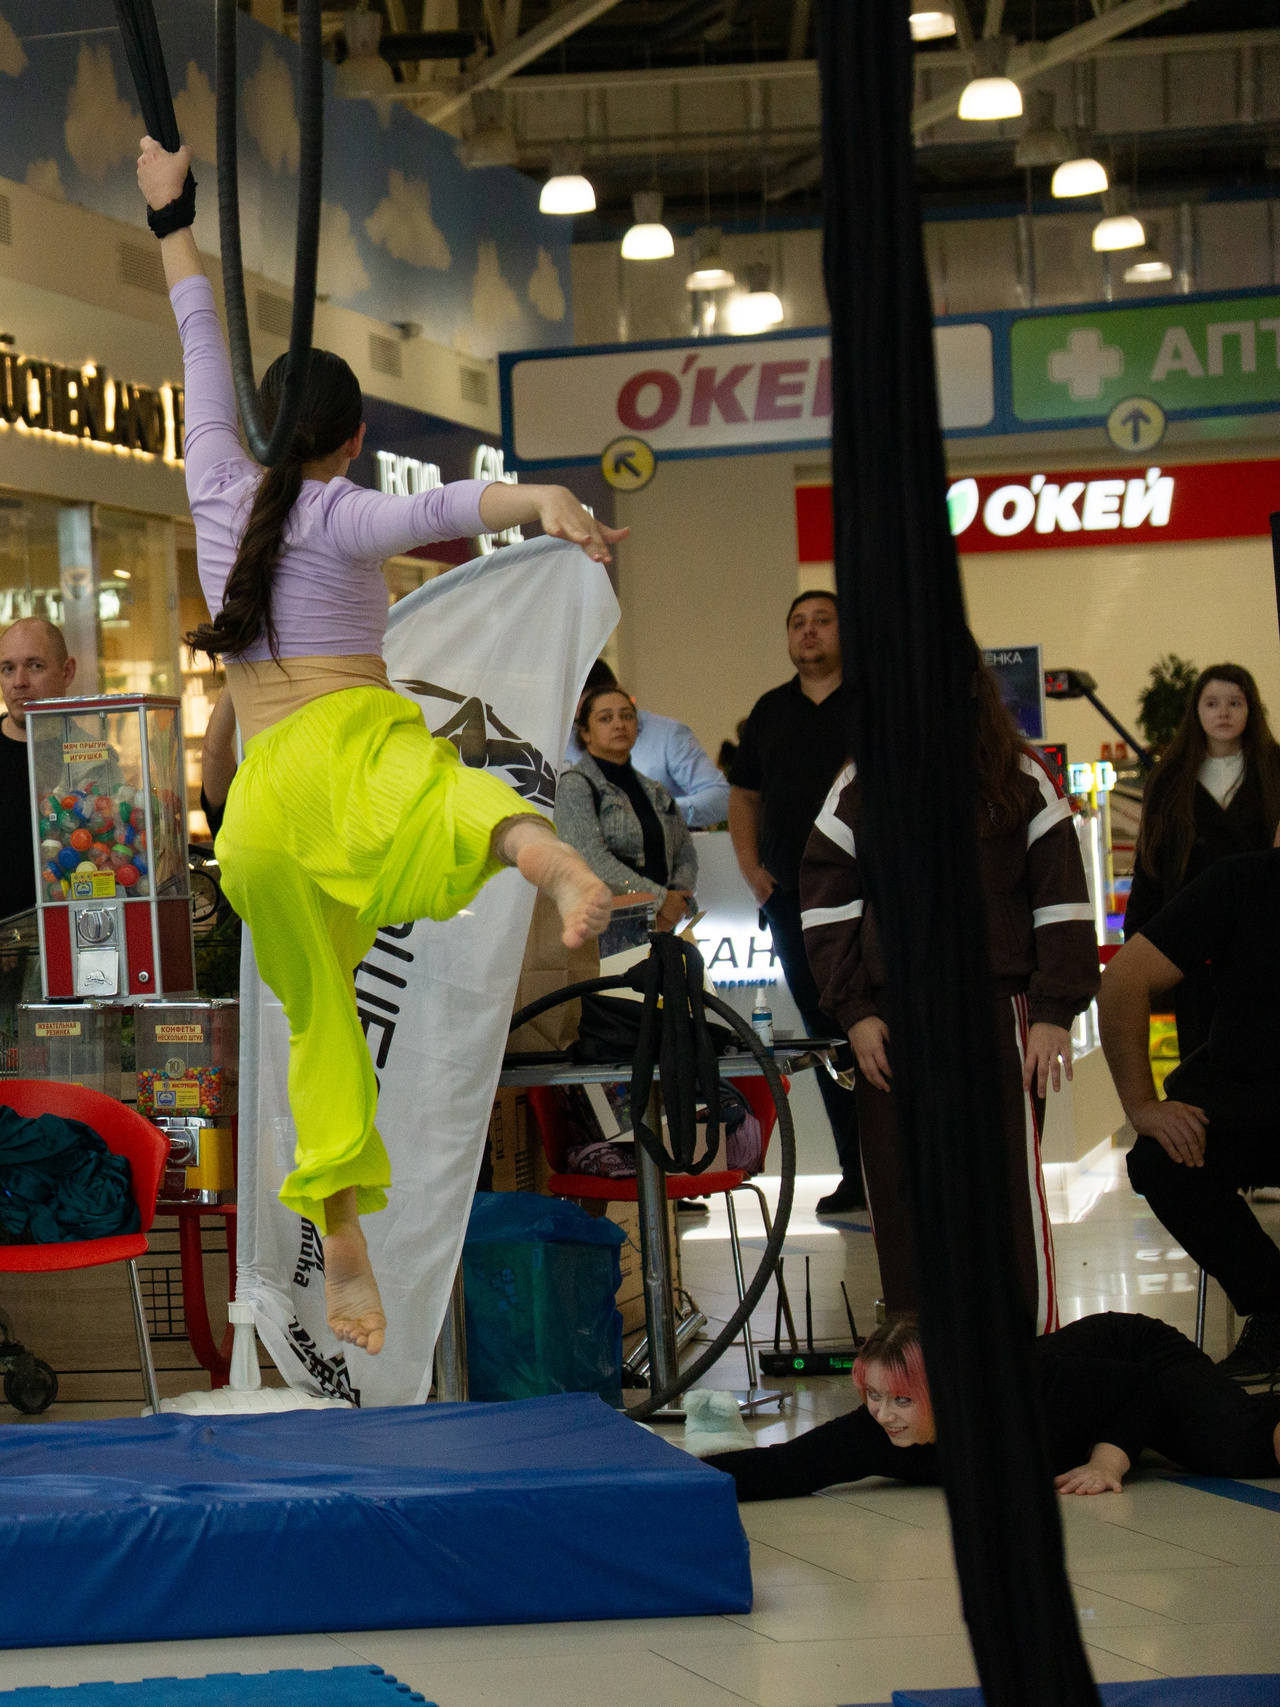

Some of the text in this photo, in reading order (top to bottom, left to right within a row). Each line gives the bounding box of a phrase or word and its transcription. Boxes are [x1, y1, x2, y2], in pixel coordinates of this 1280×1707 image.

[983, 467, 1175, 537] О'КЕЙ
[64, 742, 107, 750] МЯЧ ПРЫГУН
[70, 752, 103, 762] ИГРУШКА
[697, 936, 778, 969] АН
[38, 1022, 77, 1030] ЖЕВАТЕЛЬНАЯ
